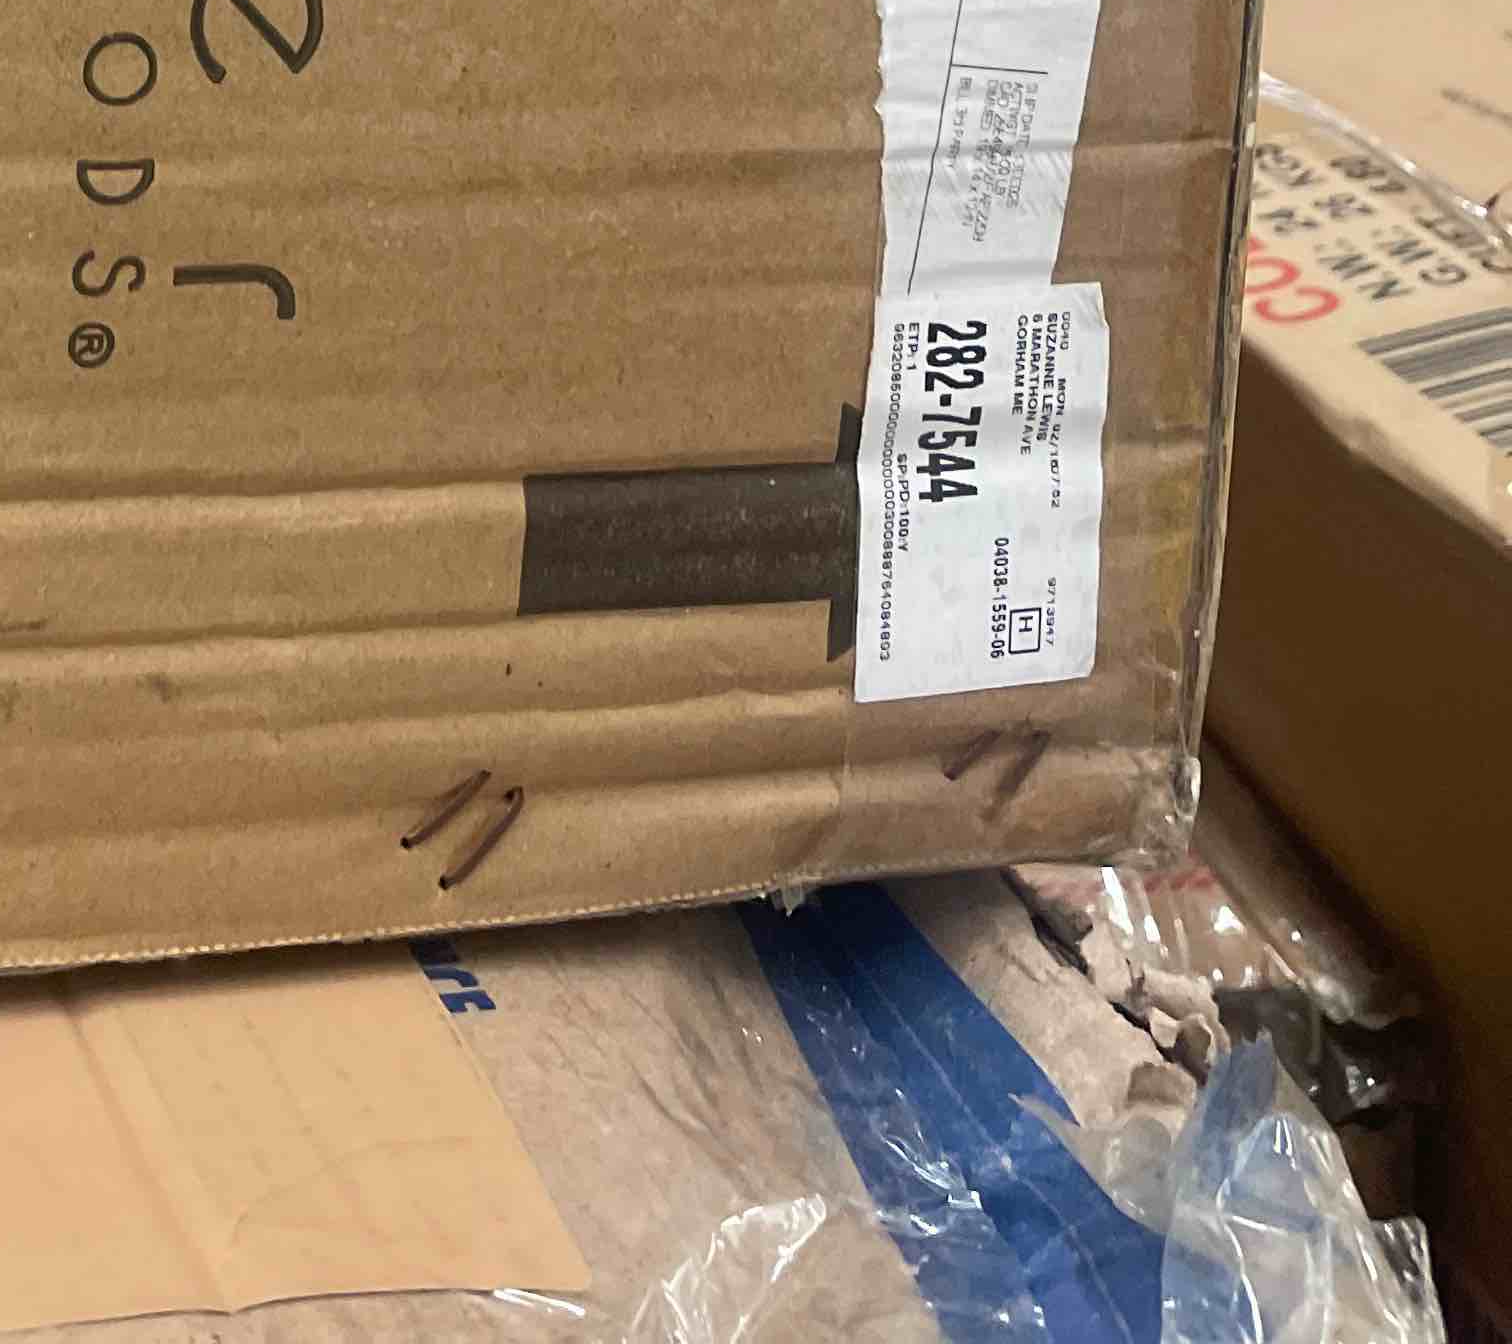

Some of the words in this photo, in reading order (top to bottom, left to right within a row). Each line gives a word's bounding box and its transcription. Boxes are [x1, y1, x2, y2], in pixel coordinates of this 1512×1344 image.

[1013, 315, 1028, 388] GORHAM
[1025, 327, 1042, 422] MARATHON
[1042, 313, 1058, 391] SUZANNE
[915, 319, 987, 505] 282-7544
[1011, 392, 1024, 415] ME
[1037, 394, 1054, 442] LEWIS
[1020, 426, 1033, 456] AVE
[1019, 615, 1033, 634] H
